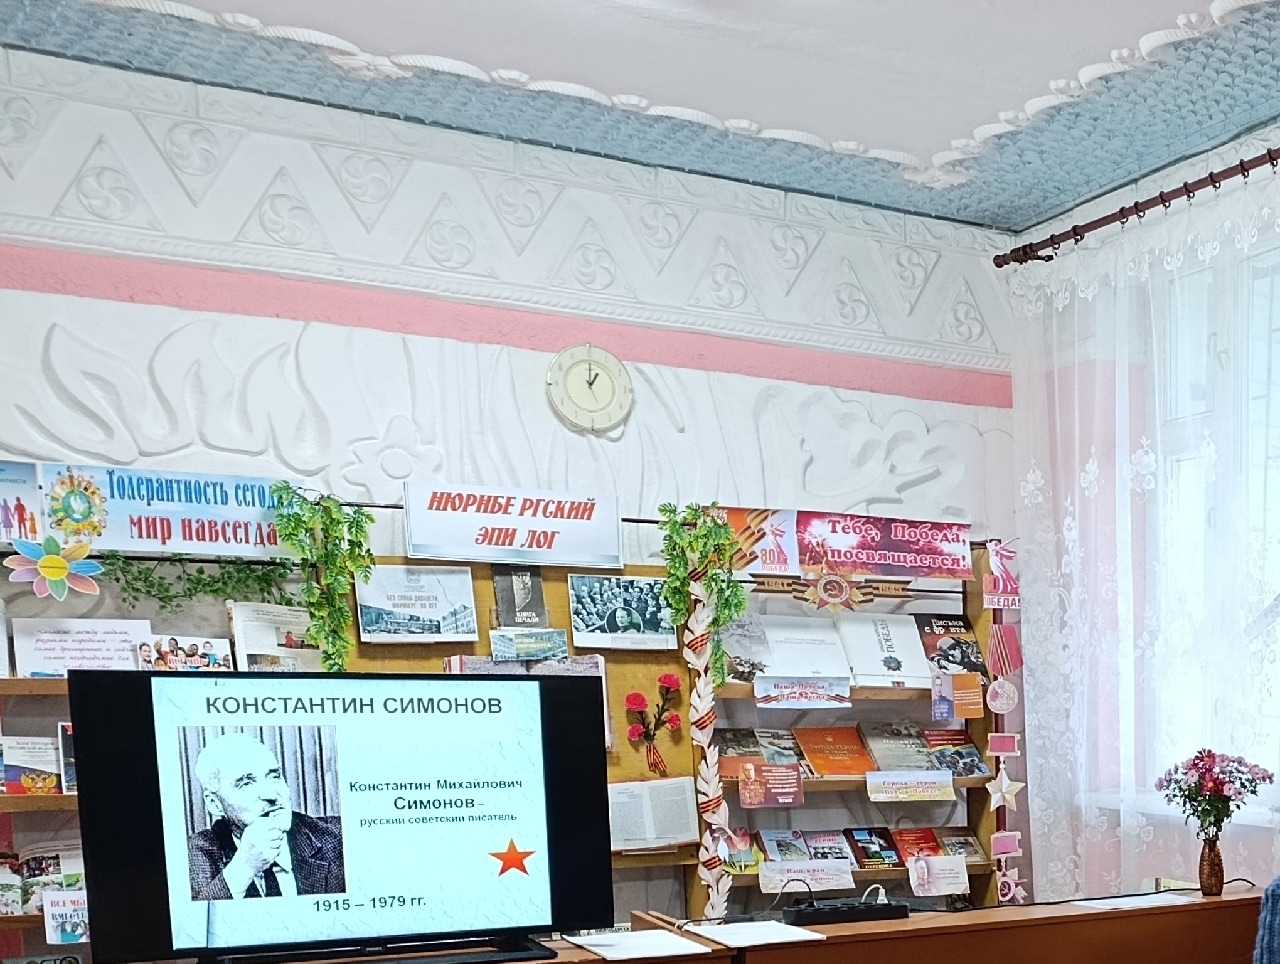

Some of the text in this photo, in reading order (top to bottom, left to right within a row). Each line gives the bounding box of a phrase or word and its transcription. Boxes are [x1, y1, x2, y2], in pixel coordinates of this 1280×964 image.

[106, 469, 229, 507] Толерантность
[427, 491, 597, 521] НЮРНБЕ РГСКИЙ
[128, 514, 279, 548] мир навсегда
[475, 526, 560, 549] ЭПИ ЛОГ
[827, 518, 967, 546] Тебе, Победа,
[760, 549, 775, 564] 80
[827, 548, 967, 569] посвящается!
[933, 626, 967, 634] фрнта
[205, 696, 503, 714] КОНСТАНТИН СИМОНОВ
[349, 778, 523, 792] Константин Михайлович
[393, 796, 475, 810] Симонов
[468, 814, 518, 822] писатель
[313, 899, 351, 912] 1915
[370, 896, 406, 909] 1979
[410, 896, 427, 907] гг.
